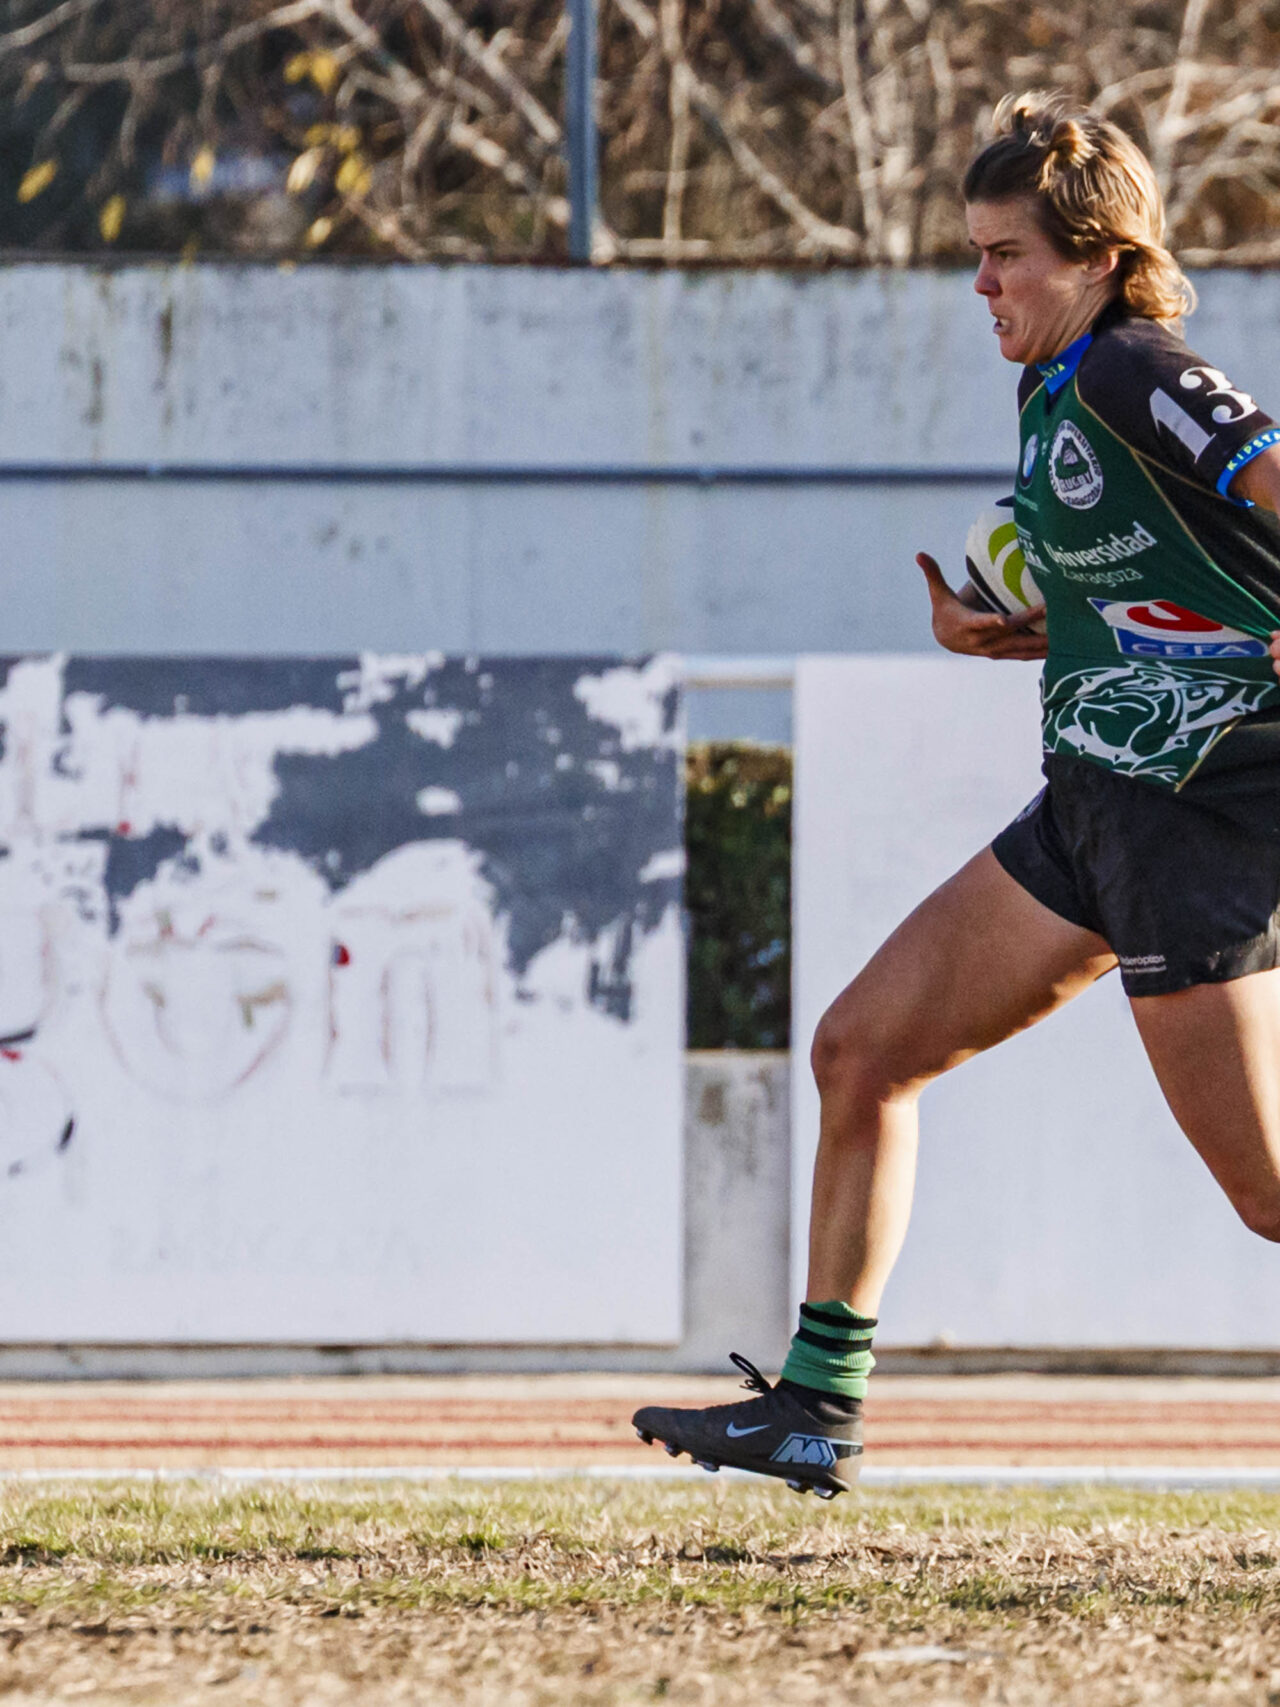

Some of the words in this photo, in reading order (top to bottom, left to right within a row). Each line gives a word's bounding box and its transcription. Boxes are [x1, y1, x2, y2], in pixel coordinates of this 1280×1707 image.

[1149, 366, 1258, 464] 13
[1042, 520, 1158, 567] Universidad
[1060, 566, 1145, 588] Zaragoza
[1131, 643, 1250, 655] CEFA
